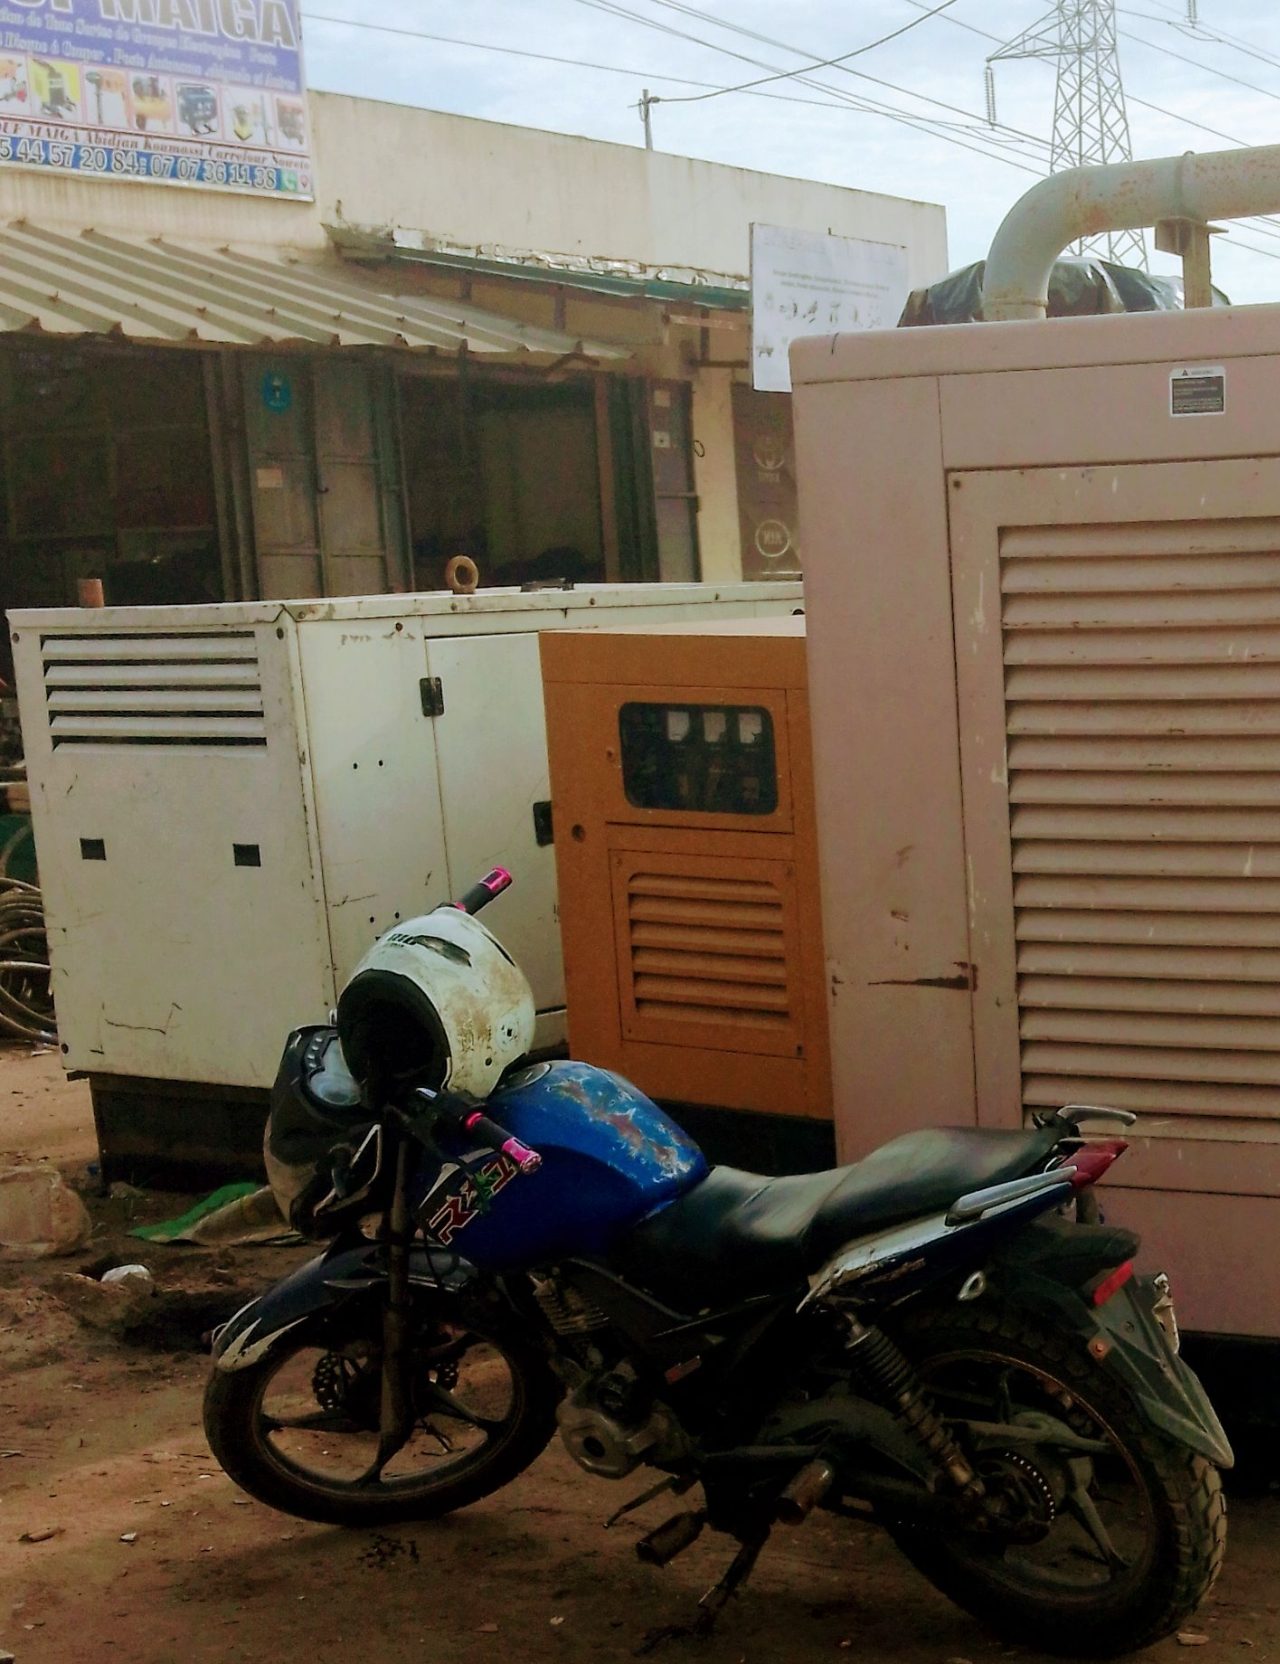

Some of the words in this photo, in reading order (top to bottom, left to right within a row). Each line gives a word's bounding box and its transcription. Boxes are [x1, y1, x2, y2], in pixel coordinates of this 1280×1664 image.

[30, 124, 81, 143] MAIGA
[88, 130, 139, 151] Abidjan
[144, 136, 204, 157] Koumassi
[16, 138, 45, 164] 44
[49, 143, 75, 168] 57
[79, 147, 107, 171] 20
[150, 155, 175, 177] 07
[176, 157, 200, 180] 07
[203, 160, 226, 184] 36
[229, 164, 252, 187] 11
[254, 167, 277, 190] 38
